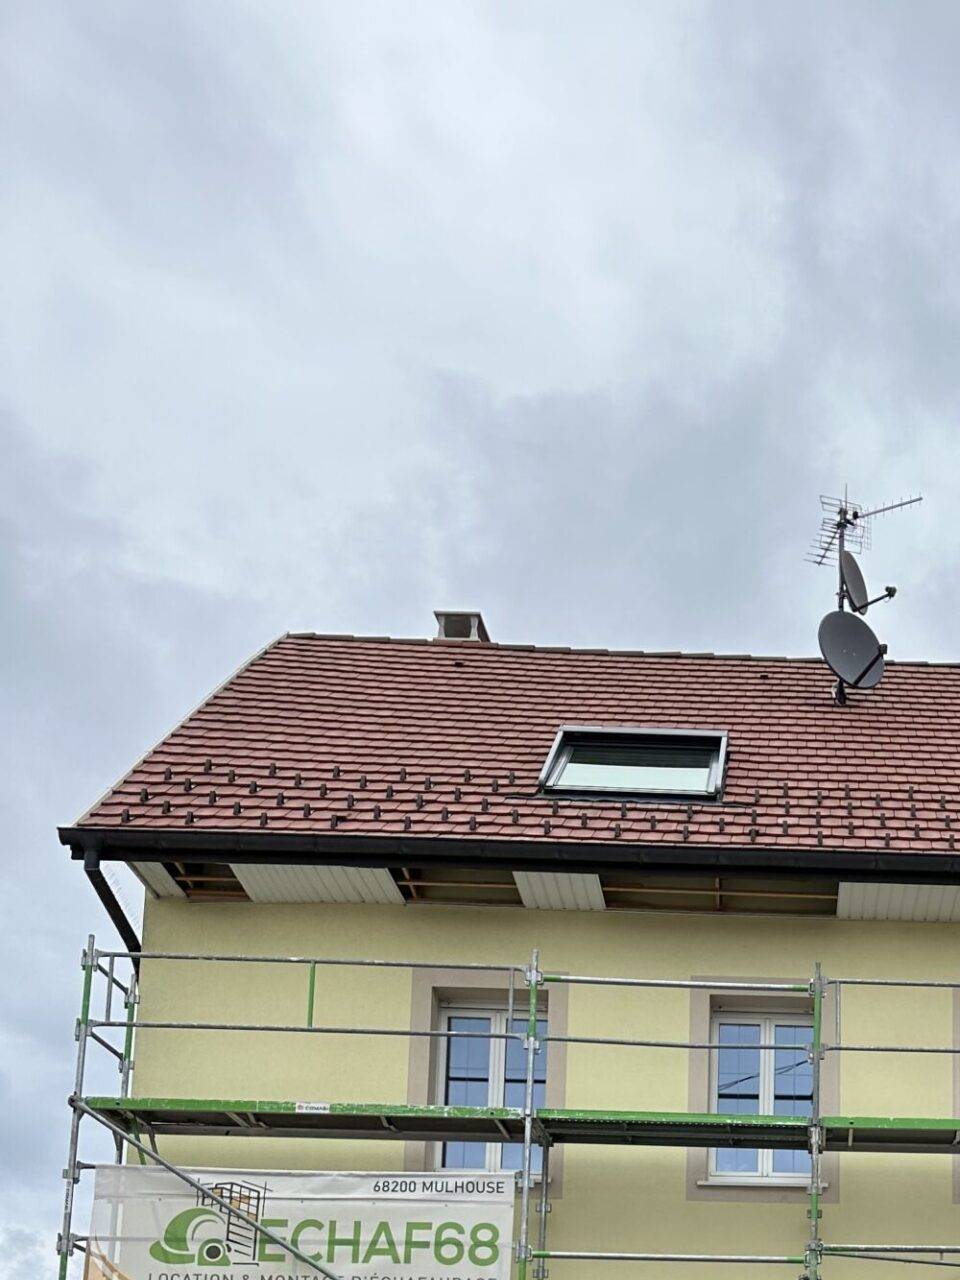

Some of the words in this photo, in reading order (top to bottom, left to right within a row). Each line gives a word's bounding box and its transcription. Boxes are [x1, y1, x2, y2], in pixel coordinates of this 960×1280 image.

[373, 1180, 417, 1193] 68200
[421, 1181, 505, 1194] MULHOUSE
[257, 1218, 500, 1267] ECHAF68
